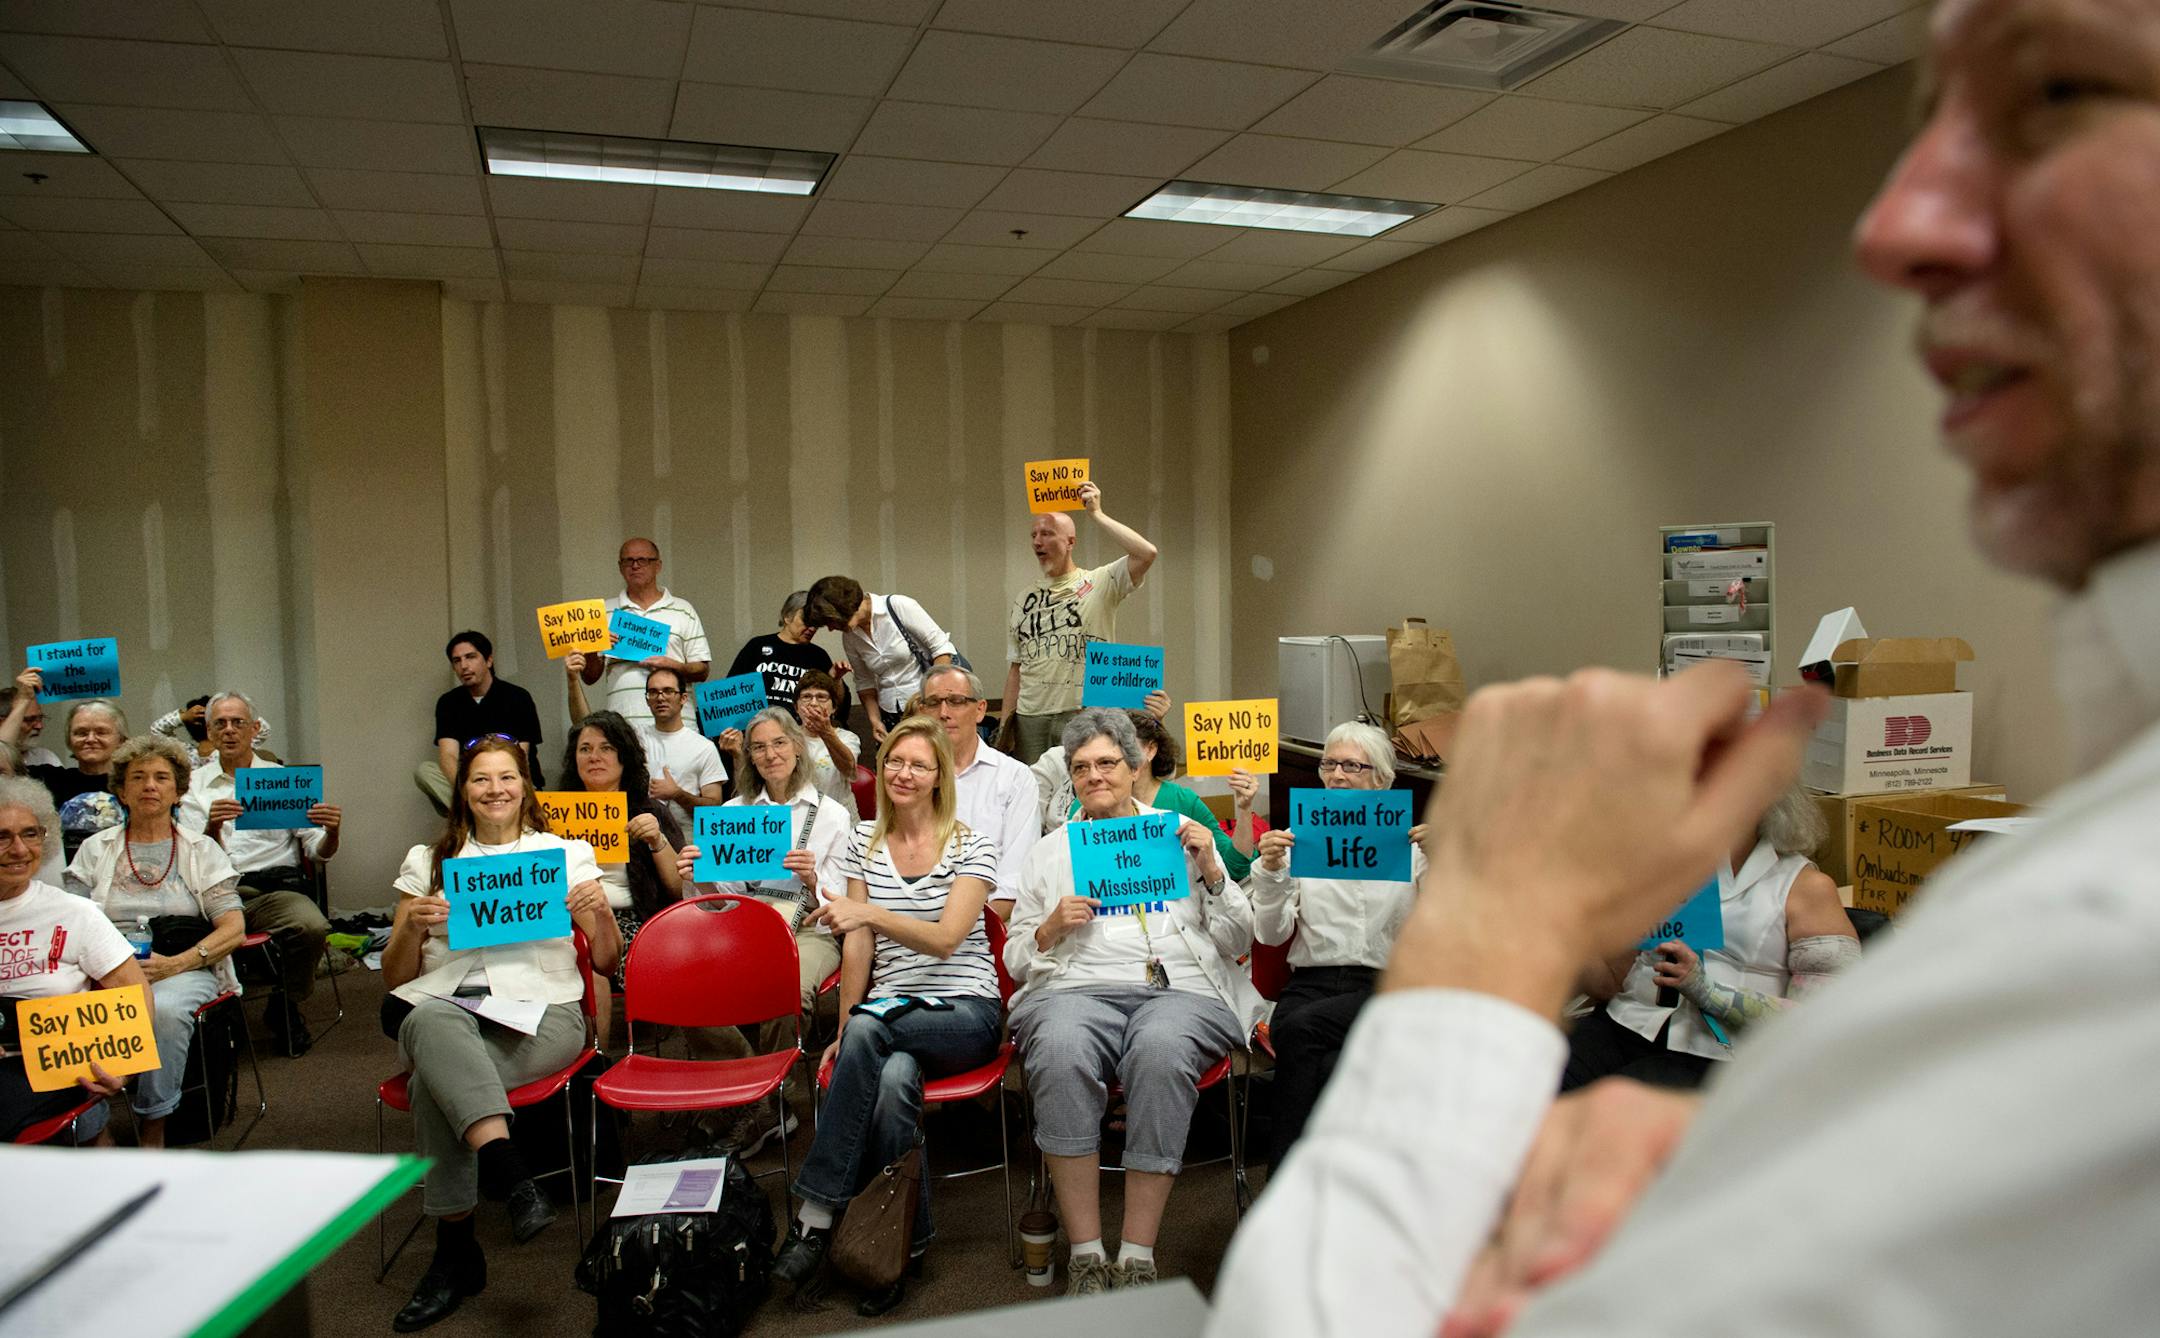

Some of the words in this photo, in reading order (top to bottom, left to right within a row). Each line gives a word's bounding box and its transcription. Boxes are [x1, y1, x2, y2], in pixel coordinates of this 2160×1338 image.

[1030, 469, 1049, 483] Say
[1053, 466, 1068, 480] NO
[1072, 467, 1084, 479] to
[544, 613, 564, 627] Say
[567, 607, 585, 621] NO
[588, 607, 601, 619] to
[549, 627, 603, 647] Enbridge
[617, 617, 622, 627] I
[623, 620, 647, 634] stand
[650, 625, 663, 639] for
[38, 649, 42, 661] I
[47, 645, 82, 661] stand
[87, 642, 106, 656] for
[627, 635, 663, 653] children
[64, 664, 86, 677] the
[1090, 651, 1109, 666] We
[1112, 653, 1141, 668] stand
[1145, 655, 1159, 669] for
[42, 679, 111, 697] Mississippi
[1090, 675, 1107, 687] our
[1111, 672, 1158, 688] children
[703, 691, 708, 702] I
[710, 684, 737, 700] stand
[739, 682, 755, 695] for
[703, 698, 765, 722] Minnesota
[1193, 713, 1223, 734] Say
[1229, 711, 1251, 730] NO
[1256, 712, 1271, 728] to
[1197, 739, 1270, 761] Enbridge
[1866, 750, 1892, 758] Business
[1894, 748, 1907, 756] Data
[1909, 747, 1928, 755] Record
[1930, 745, 1953, 755] Services
[1914, 766, 1948, 775] Minnesota
[246, 776, 250, 790] I
[255, 776, 290, 790] stand
[295, 775, 313, 789] for
[542, 802, 570, 823] Say
[575, 802, 598, 820] NO
[603, 804, 620, 820] to
[1298, 803, 1303, 825] I
[1310, 805, 1366, 826] stand
[1374, 803, 1406, 826] for
[699, 817, 705, 836] I
[710, 817, 755, 836] stand
[762, 815, 786, 834] for
[1081, 828, 1087, 845] I
[1092, 823, 1136, 845] stand
[1142, 820, 1167, 840] for
[1878, 818, 1934, 853] ROOM
[712, 843, 775, 866] Water
[1114, 850, 1142, 869] the
[1326, 836, 1378, 868] Life
[453, 871, 460, 893] I
[467, 866, 523, 892] stand
[530, 863, 561, 885] for
[1088, 873, 1176, 899] Mississippi
[470, 899, 548, 928] Water
[29, 1011, 70, 1037] Say
[77, 1002, 109, 1029] NO
[114, 1001, 138, 1021] to
[37, 1033, 144, 1072] Enbridge
